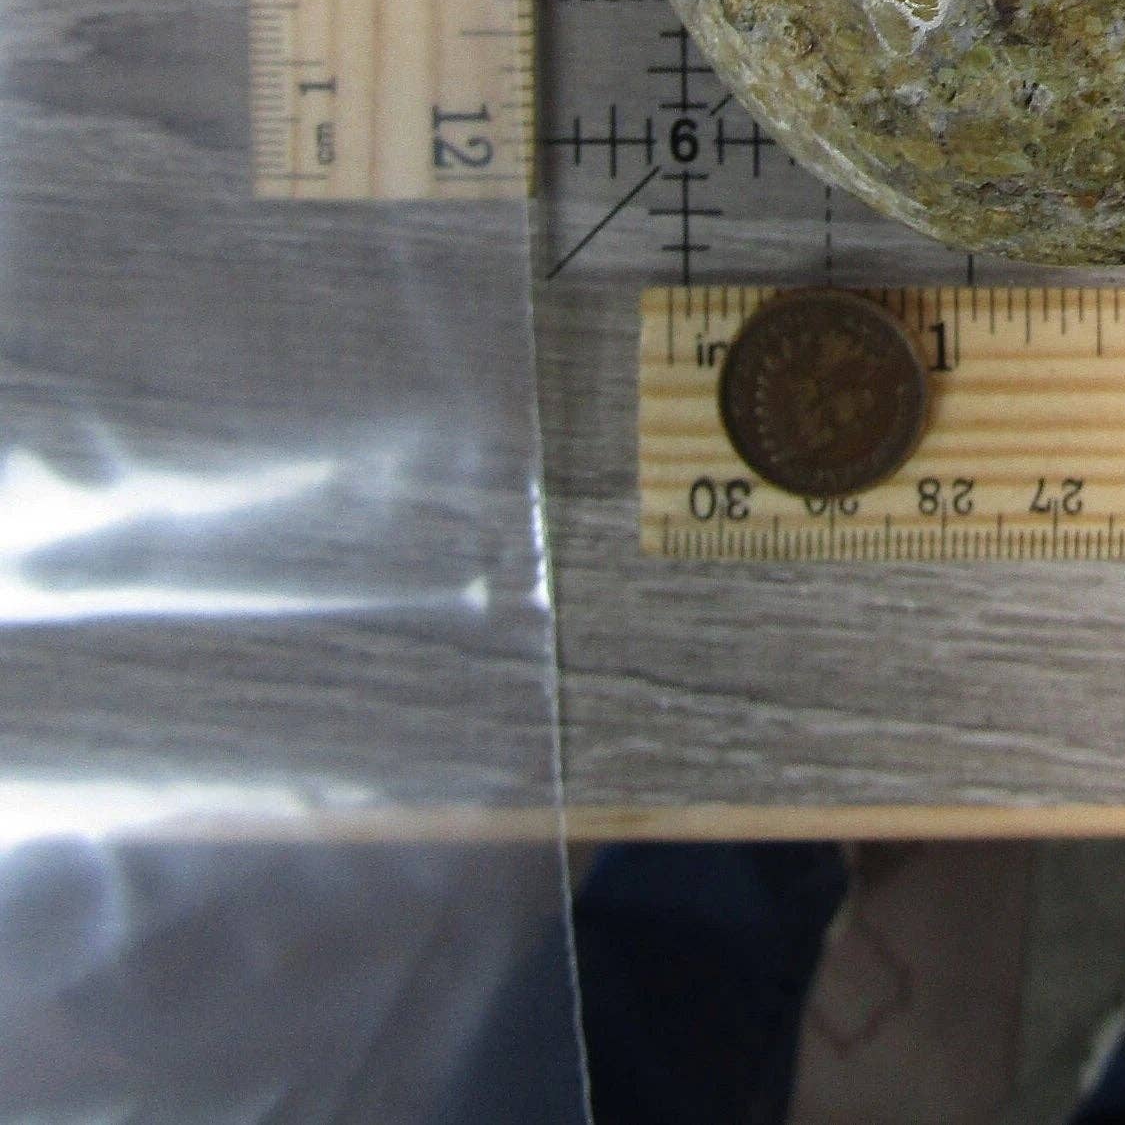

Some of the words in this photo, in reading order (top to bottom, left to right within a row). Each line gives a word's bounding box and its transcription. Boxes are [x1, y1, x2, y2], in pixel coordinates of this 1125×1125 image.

[298, 75, 336, 97] 1
[316, 121, 335, 165] cm
[432, 103, 494, 168] 12
[669, 118, 699, 164] 6
[929, 322, 952, 372] 1
[690, 478, 751, 520] 30
[918, 477, 974, 516] 28
[1028, 478, 1083, 515] 27
